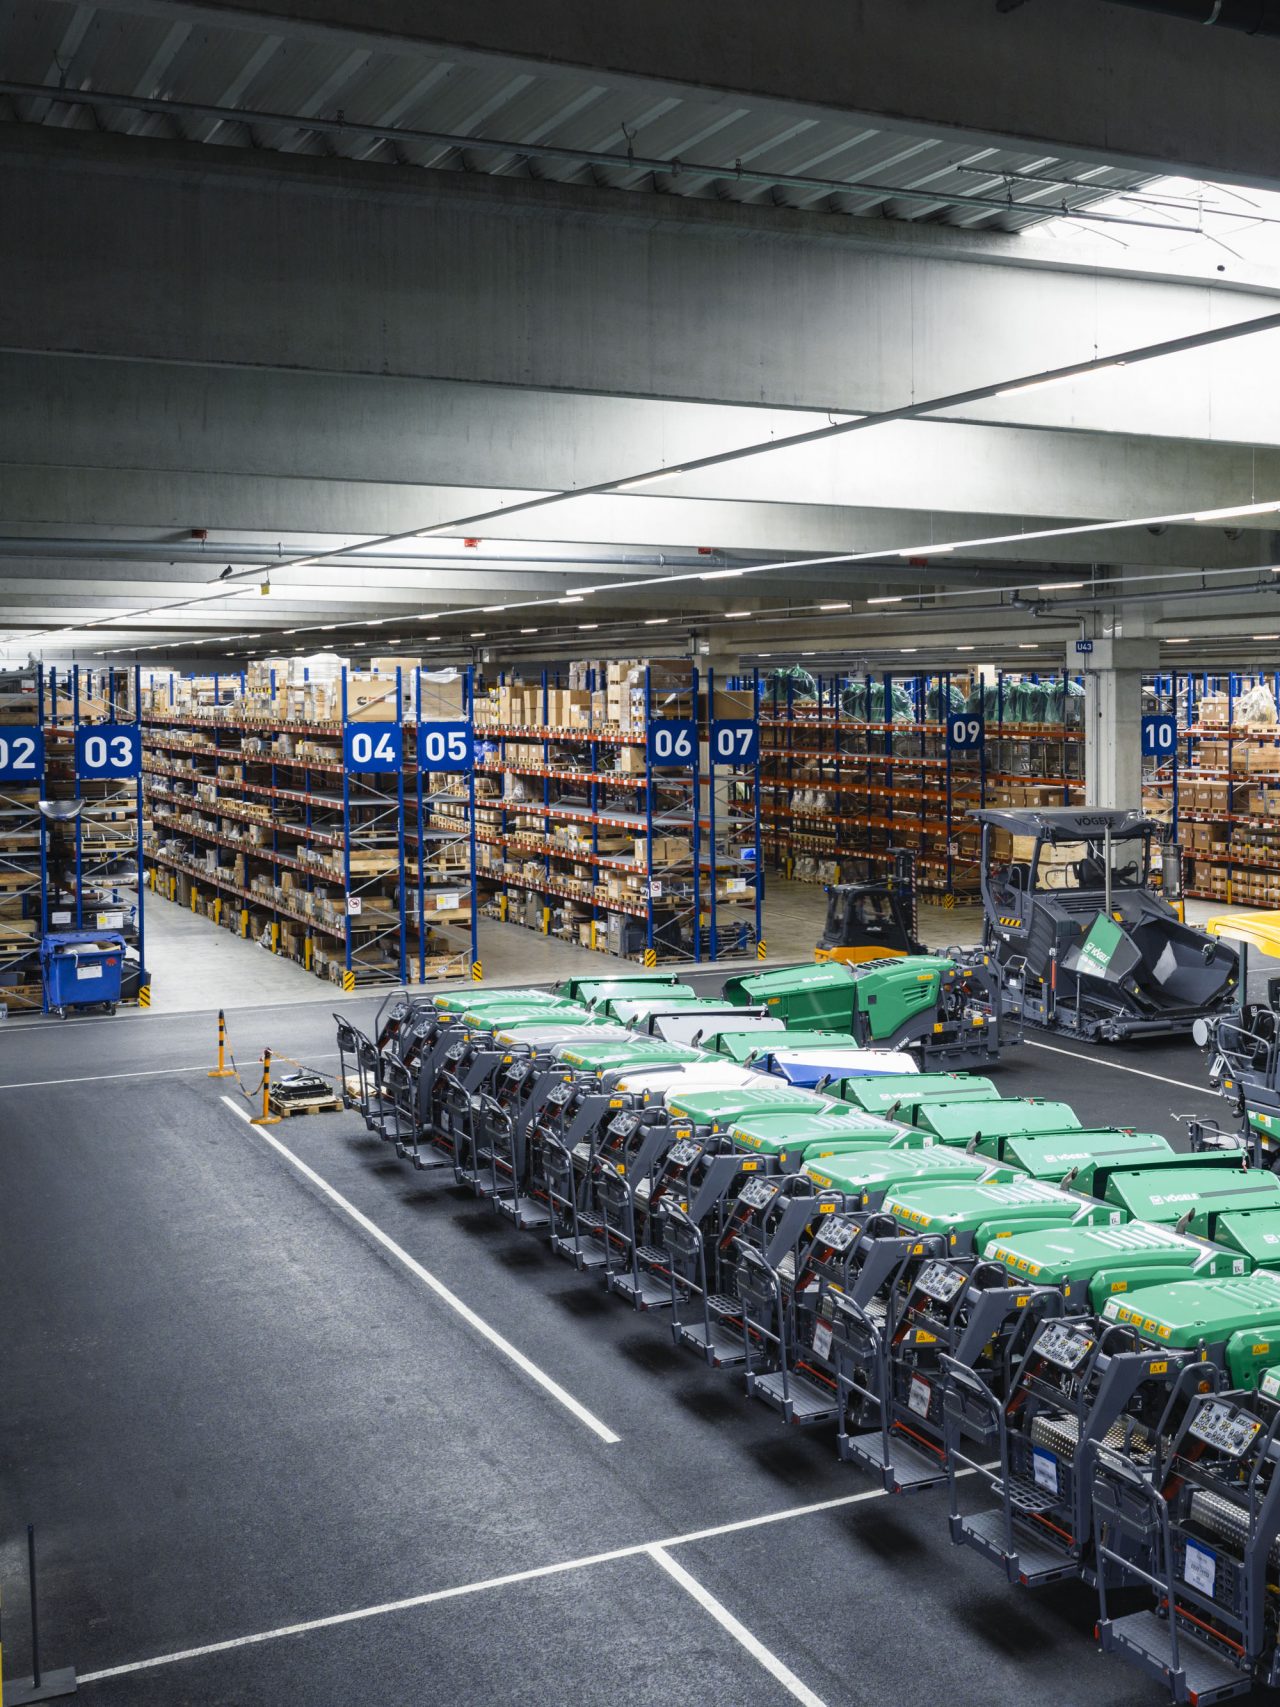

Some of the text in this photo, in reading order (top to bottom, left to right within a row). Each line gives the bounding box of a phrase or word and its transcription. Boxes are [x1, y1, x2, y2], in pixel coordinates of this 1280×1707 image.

[655, 729, 692, 757] 06
[717, 728, 753, 756] 07
[953, 720, 980, 743] 09
[1145, 723, 1172, 748] 10
[84, 736, 133, 768] 03
[352, 732, 396, 763] 04
[425, 731, 467, 762] 05
[1164, 1192, 1200, 1203] VÖGELE
